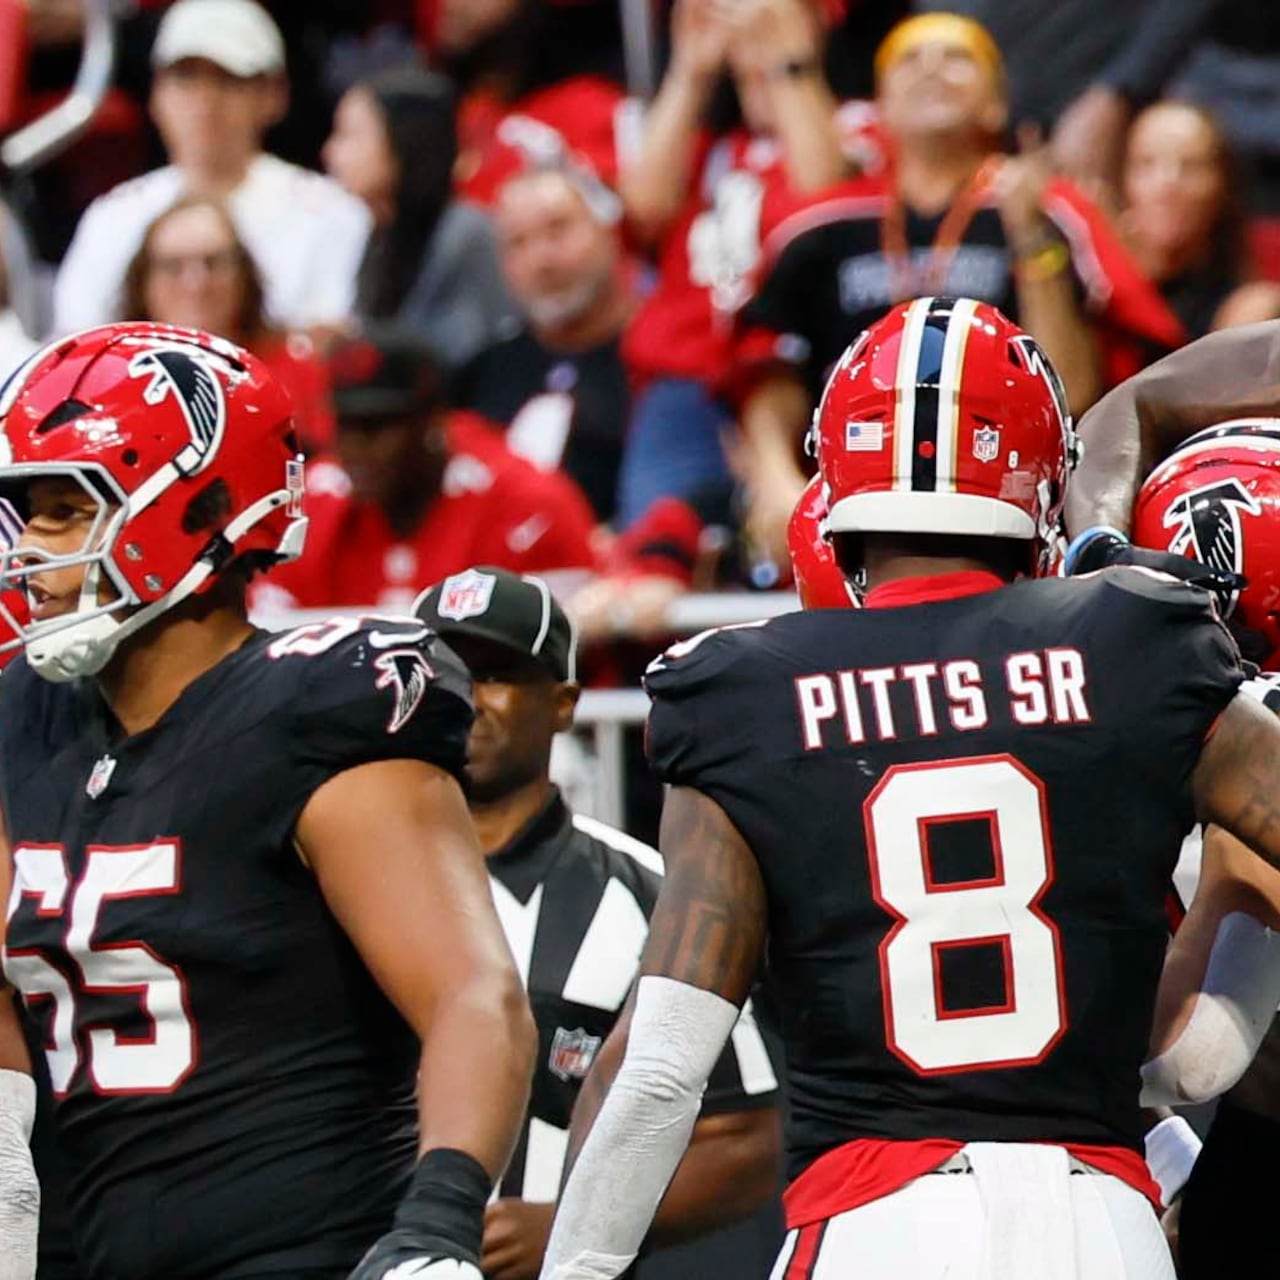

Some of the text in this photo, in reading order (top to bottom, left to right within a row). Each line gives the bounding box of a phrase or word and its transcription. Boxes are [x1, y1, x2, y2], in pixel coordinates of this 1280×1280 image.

[1007, 450, 1019, 469] 8
[795, 647, 1091, 750] PITTS SR
[1, 836, 201, 1101] 65
[862, 753, 1068, 1077] 8
